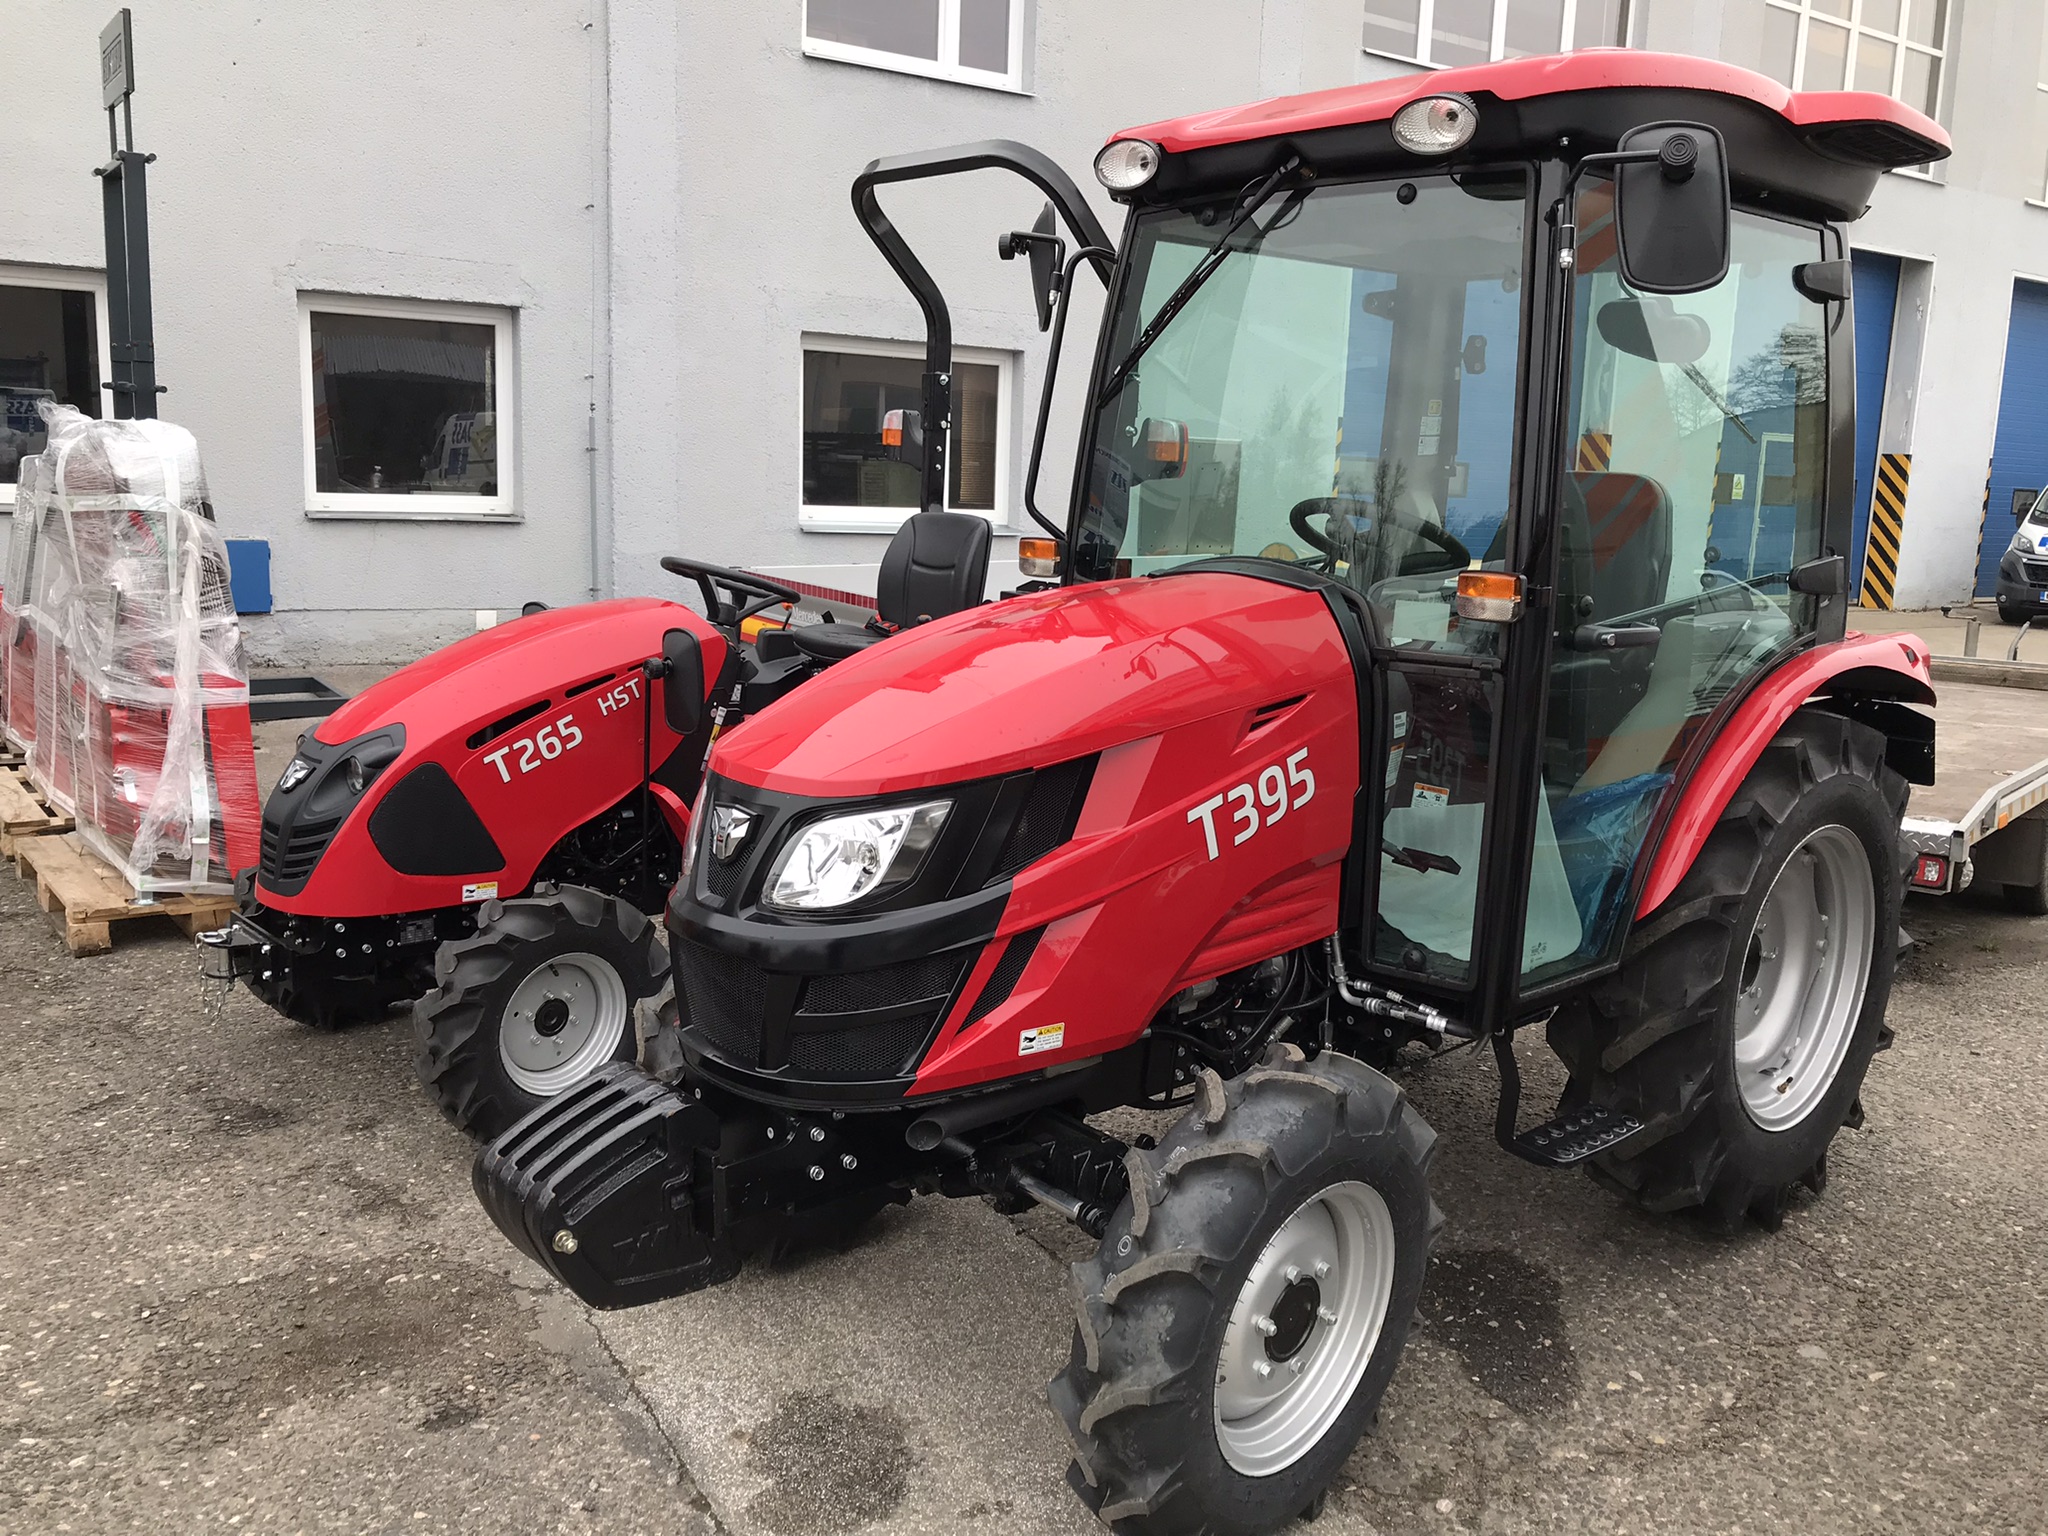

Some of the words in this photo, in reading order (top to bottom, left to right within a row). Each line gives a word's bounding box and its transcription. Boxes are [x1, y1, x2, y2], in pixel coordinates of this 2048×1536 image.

[597, 677, 641, 717] HST
[482, 714, 583, 784] T265
[1186, 746, 1317, 862] T395
